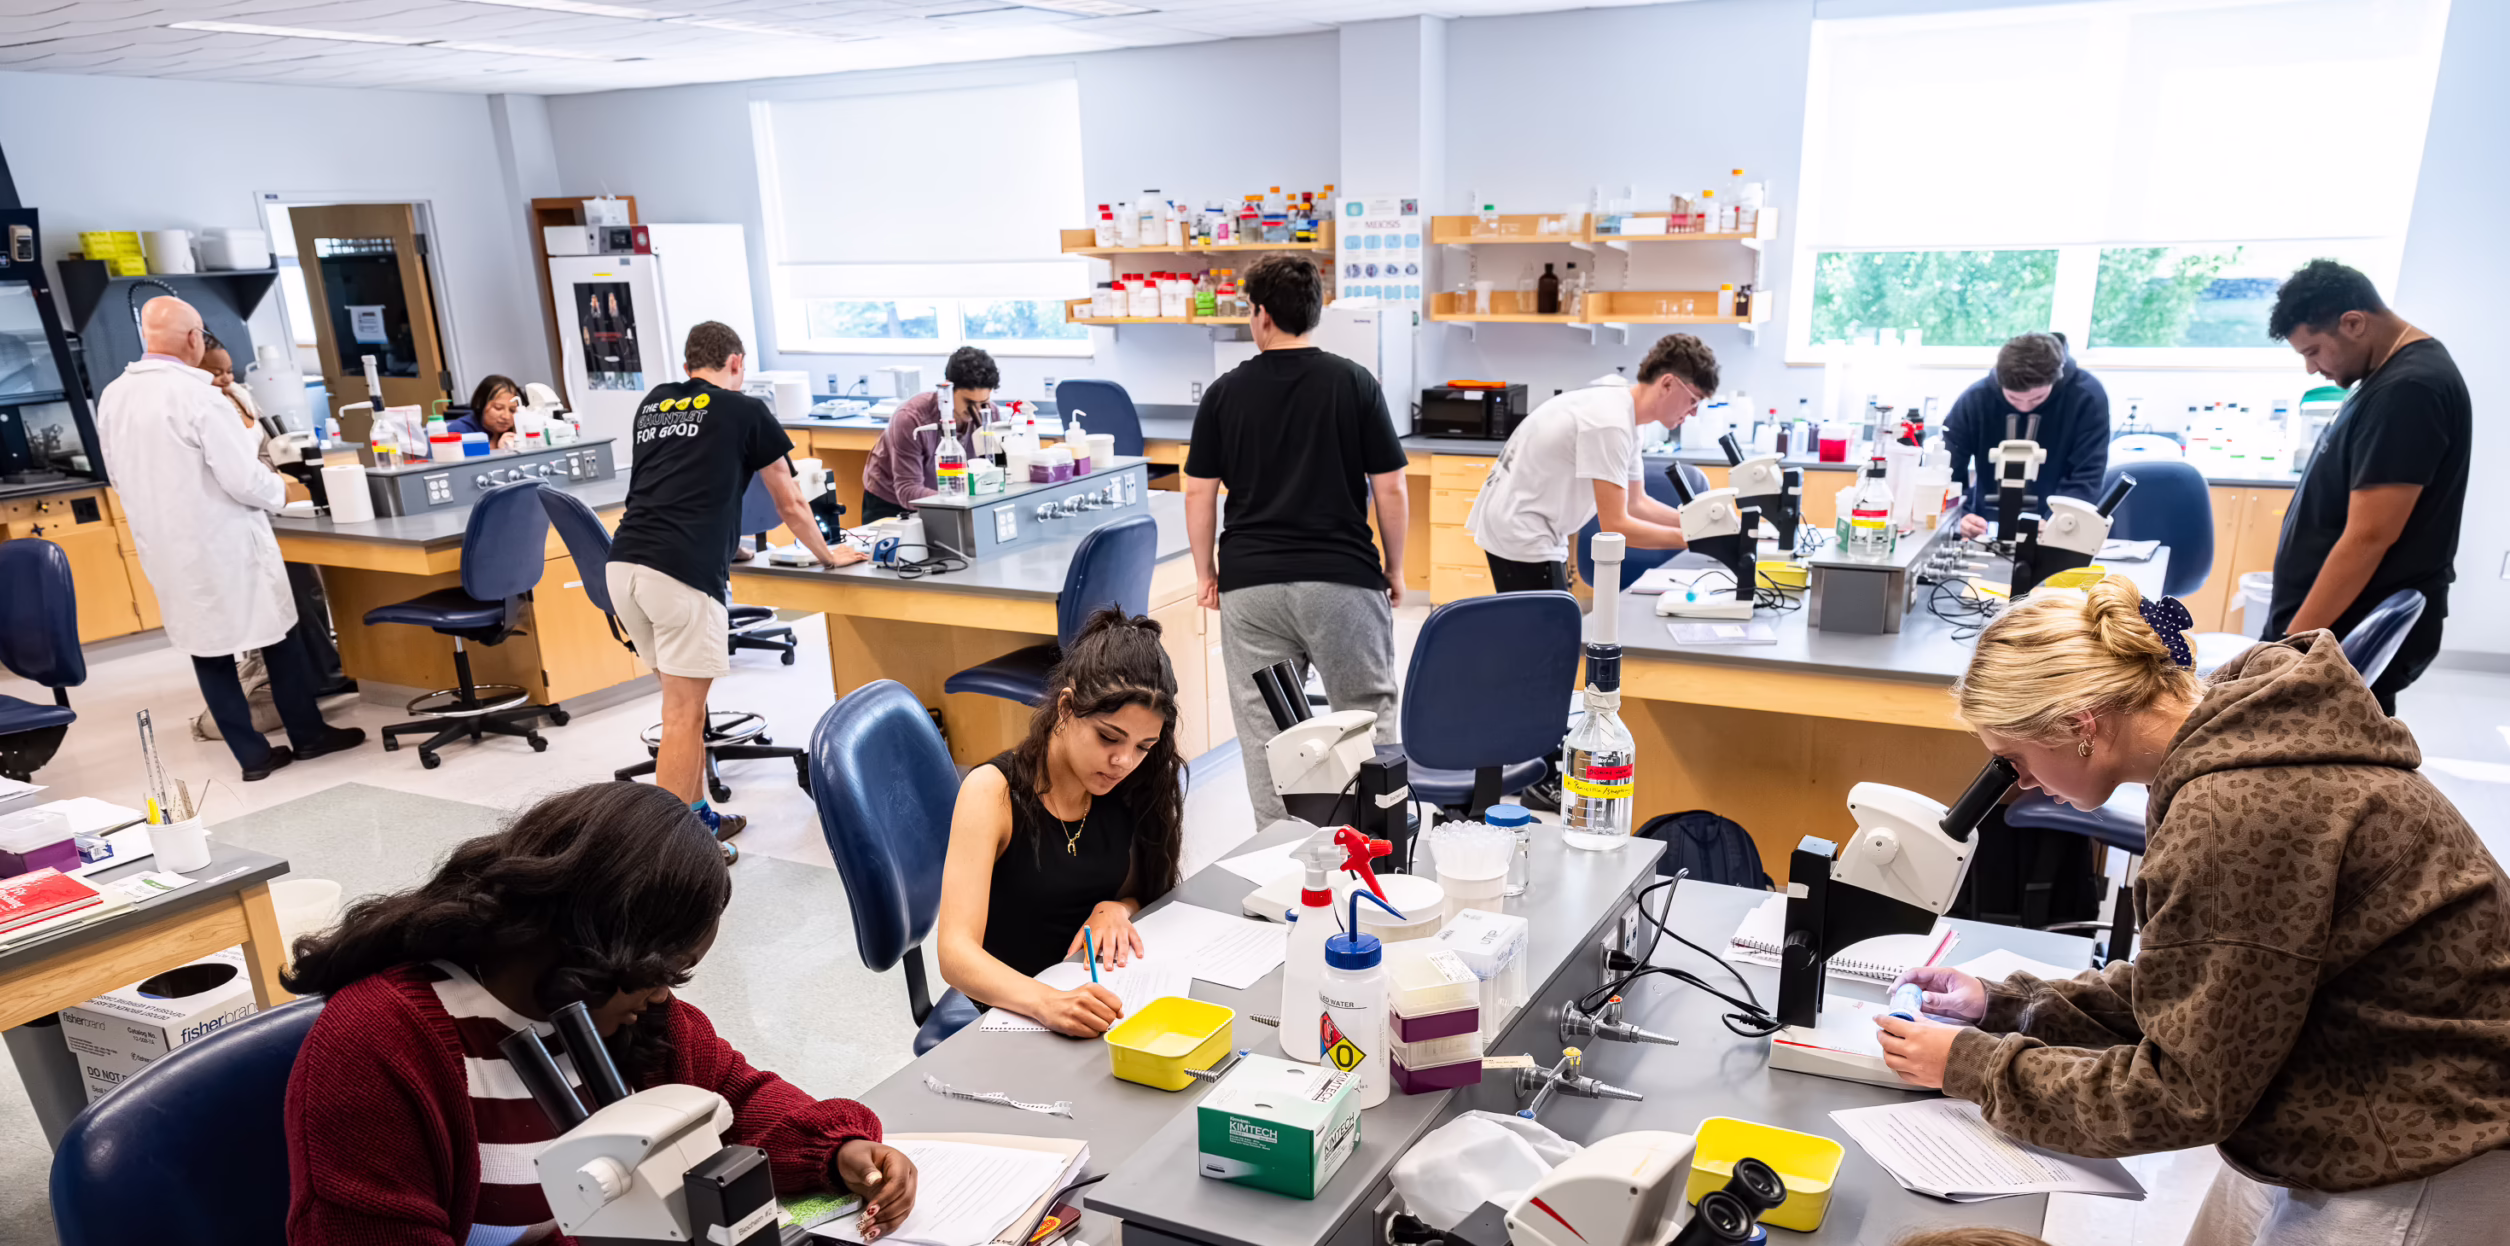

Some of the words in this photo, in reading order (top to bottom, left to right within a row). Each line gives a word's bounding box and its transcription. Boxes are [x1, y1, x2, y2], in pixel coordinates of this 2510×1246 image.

[642, 403, 659, 414] THE
[637, 410, 707, 429] GAUNTLET
[636, 427, 656, 444] FOR
[659, 422, 699, 438] GOOD
[1330, 998, 1355, 1008] WATER
[62, 1011, 106, 1031] fisherbrand
[181, 1002, 257, 1044] fisherbran
[127, 1026, 147, 1038] Catalog
[147, 1031, 158, 1040] No.
[87, 1065, 101, 1078] DO
[101, 1069, 121, 1083] NOT
[1229, 1121, 1278, 1139] KIMTECH
[1324, 1112, 1356, 1156] KIMTECH
[738, 1215, 763, 1236] Biochem
